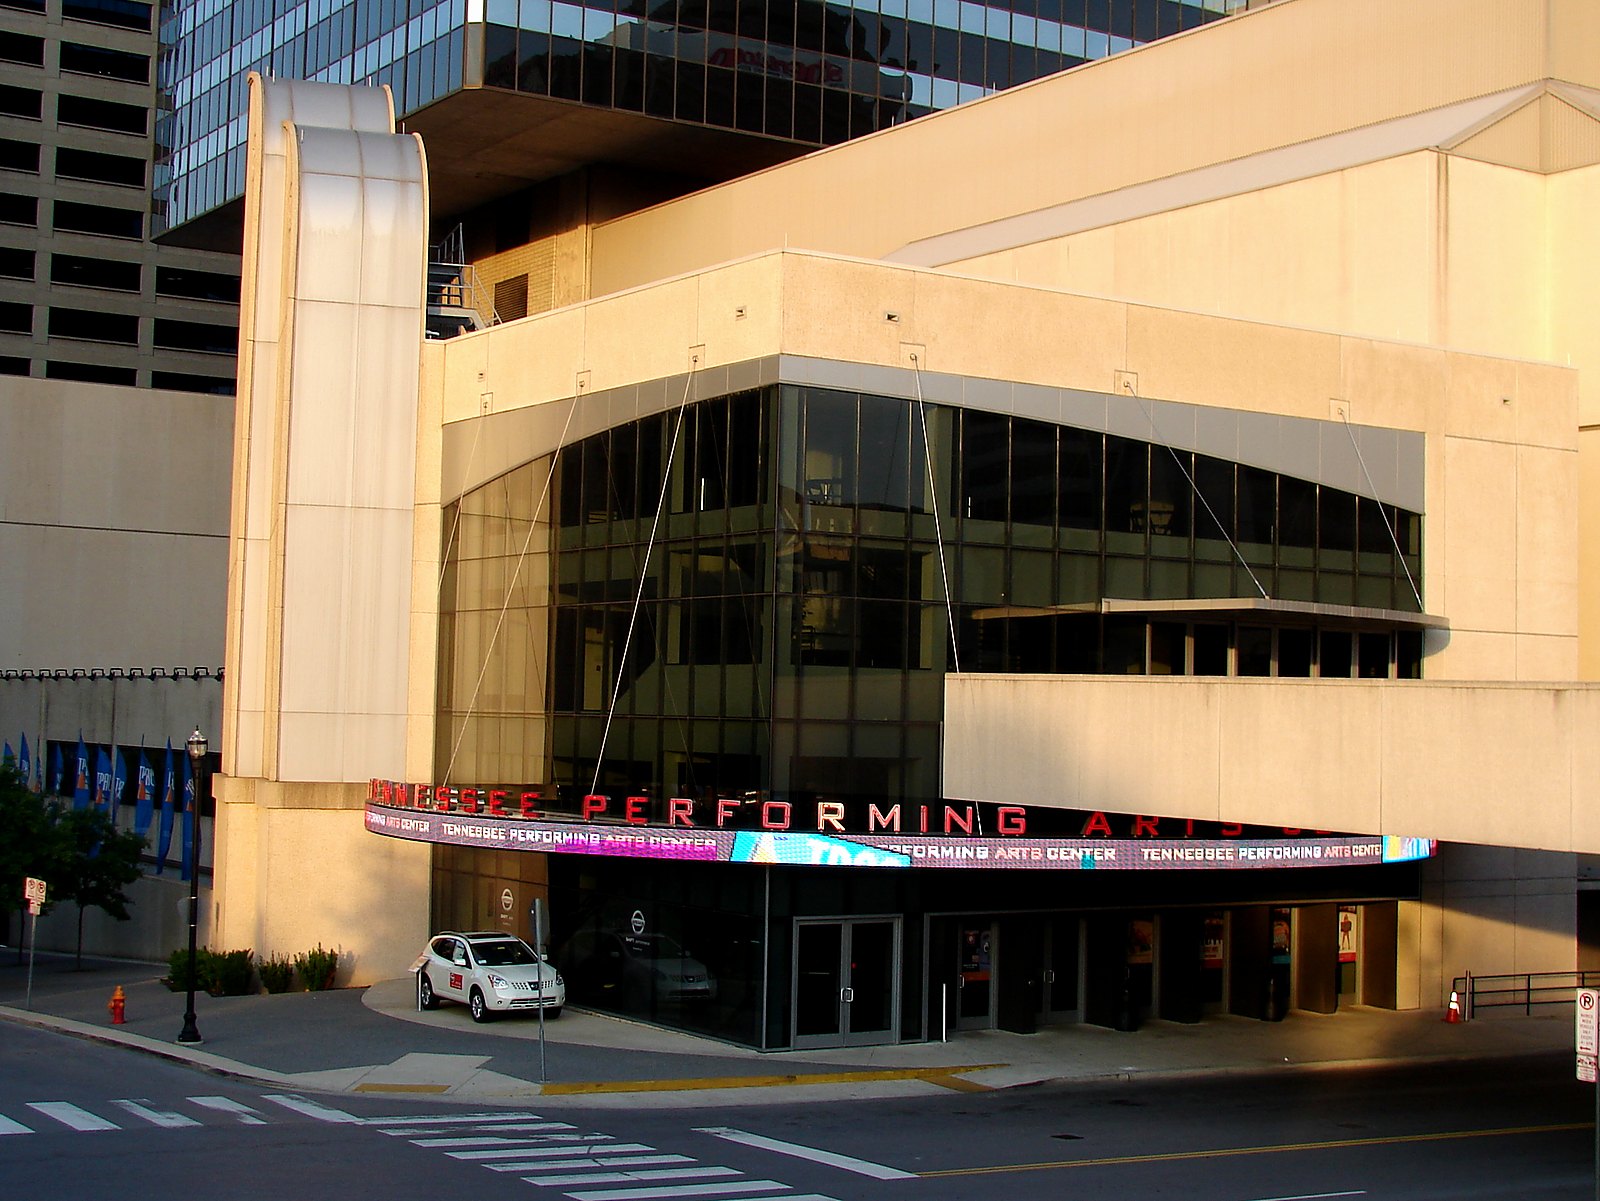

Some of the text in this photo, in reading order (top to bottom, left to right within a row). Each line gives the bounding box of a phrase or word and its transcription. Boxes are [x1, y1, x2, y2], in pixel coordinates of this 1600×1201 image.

[138, 765, 155, 787] TPAC
[401, 818, 430, 833] CENTER
[583, 795, 1027, 836] PERFORMING
[442, 822, 506, 841] TENNESSEE
[509, 829, 600, 845] PERFORMING
[995, 847, 1044, 860] ARTS
[1046, 847, 1116, 861] CENTER
[1141, 843, 1382, 861] TENNESSEE PERFORMING ARTS CENTE
